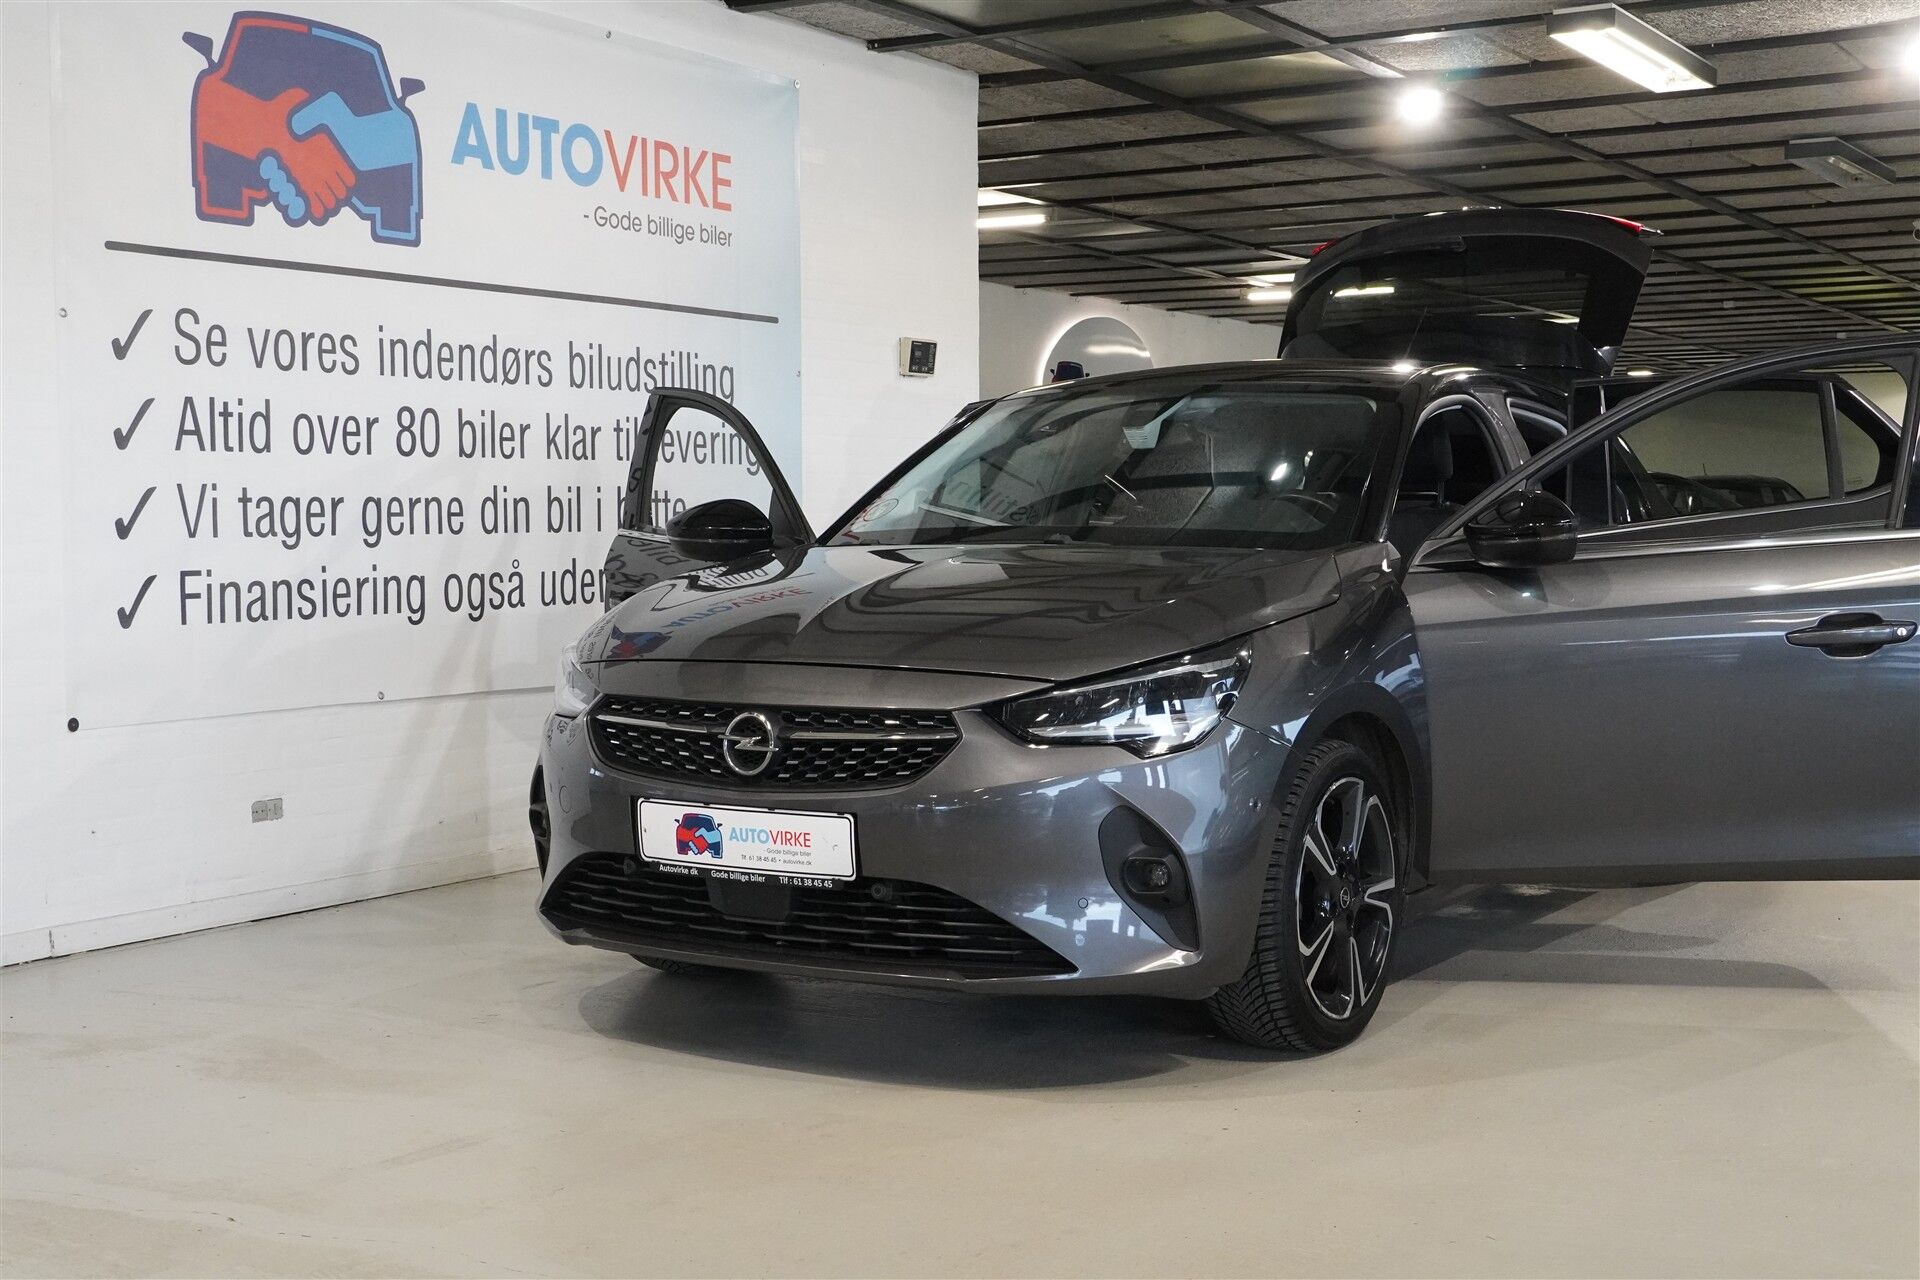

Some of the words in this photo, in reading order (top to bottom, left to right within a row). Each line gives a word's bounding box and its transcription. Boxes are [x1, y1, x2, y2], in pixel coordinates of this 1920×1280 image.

[451, 102, 732, 212] AUTOVIRKE
[594, 206, 642, 233] Gode
[647, 214, 695, 245] billige
[699, 223, 733, 247] biler
[175, 308, 227, 367] Se
[247, 328, 360, 376] vores
[378, 325, 553, 388] indendørs
[568, 340, 735, 406] biludstilling
[175, 397, 272, 454] Altid
[292, 413, 380, 457] over
[396, 406, 441, 458] 80
[457, 408, 531, 460] biler
[545, 412, 602, 462] klar
[656, 421, 761, 477] evering
[177, 483, 219, 539] Vi
[238, 488, 345, 550] tager
[362, 496, 464, 548] gerne
[481, 485, 531, 535] din
[546, 485, 582, 534] bil
[596, 486, 602, 532] i
[180, 562, 426, 626] Finansiering
[443, 558, 527, 623] også
[729, 827, 811, 848] AUTOVIRKE
[659, 864, 689, 875] Autovirke
[711, 870, 729, 879] Gode
[729, 871, 749, 882] billige
[750, 874, 766, 883] biler
[793, 878, 802, 886] 61
[803, 879, 812, 887] 38
[813, 879, 822, 887] 45
[823, 880, 833, 888] 45
